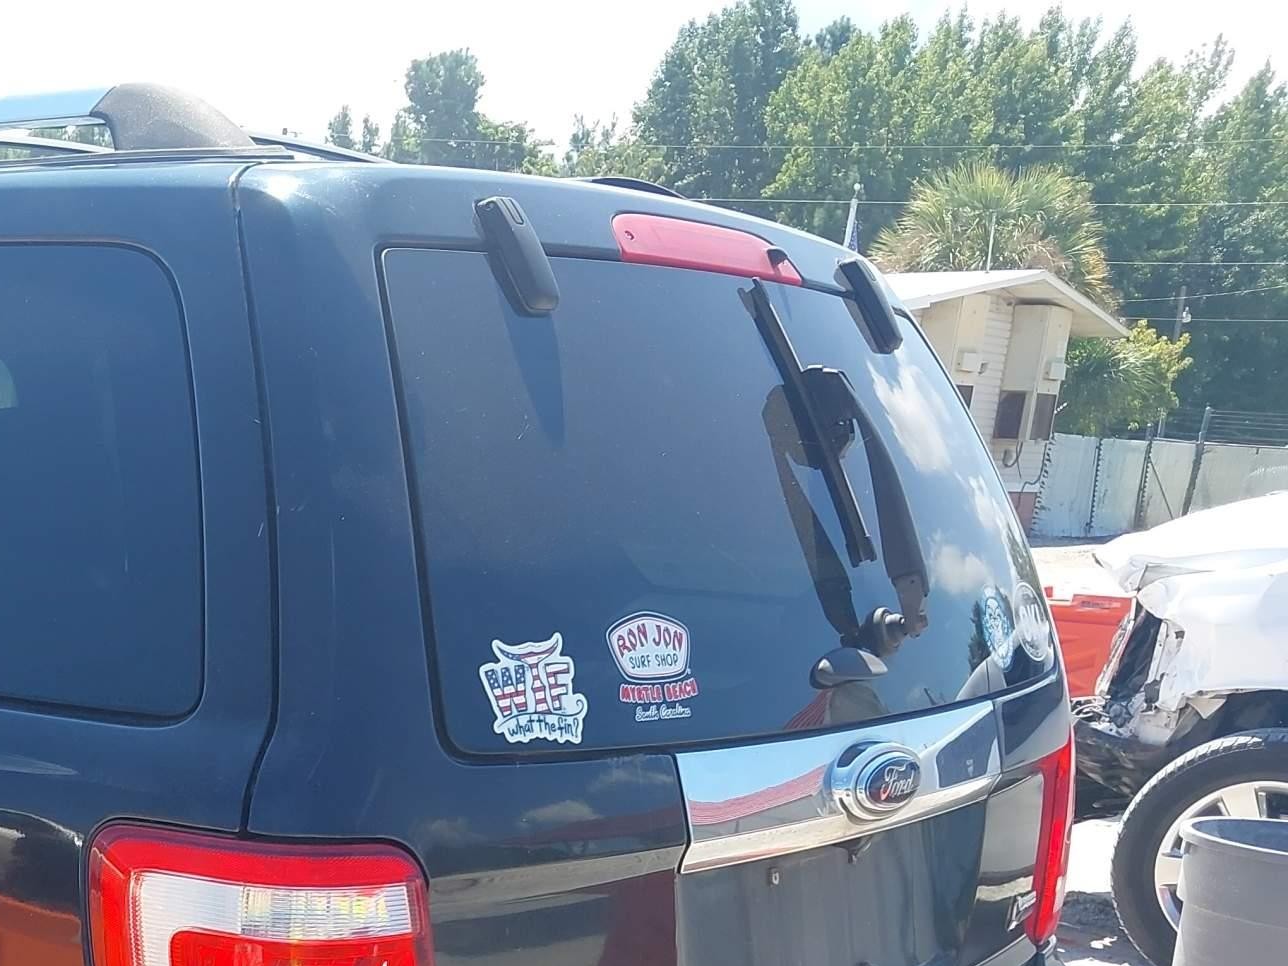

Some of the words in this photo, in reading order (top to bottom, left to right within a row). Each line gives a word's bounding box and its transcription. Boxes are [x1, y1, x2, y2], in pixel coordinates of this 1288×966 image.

[617, 623, 648, 658] RON
[653, 625, 683, 652] JON
[629, 655, 651, 669] SURF
[655, 653, 679, 667] SHOP
[620, 684, 663, 703] MYRTLE
[664, 678, 699, 702] BEACH
[880, 761, 916, 801] Ford
